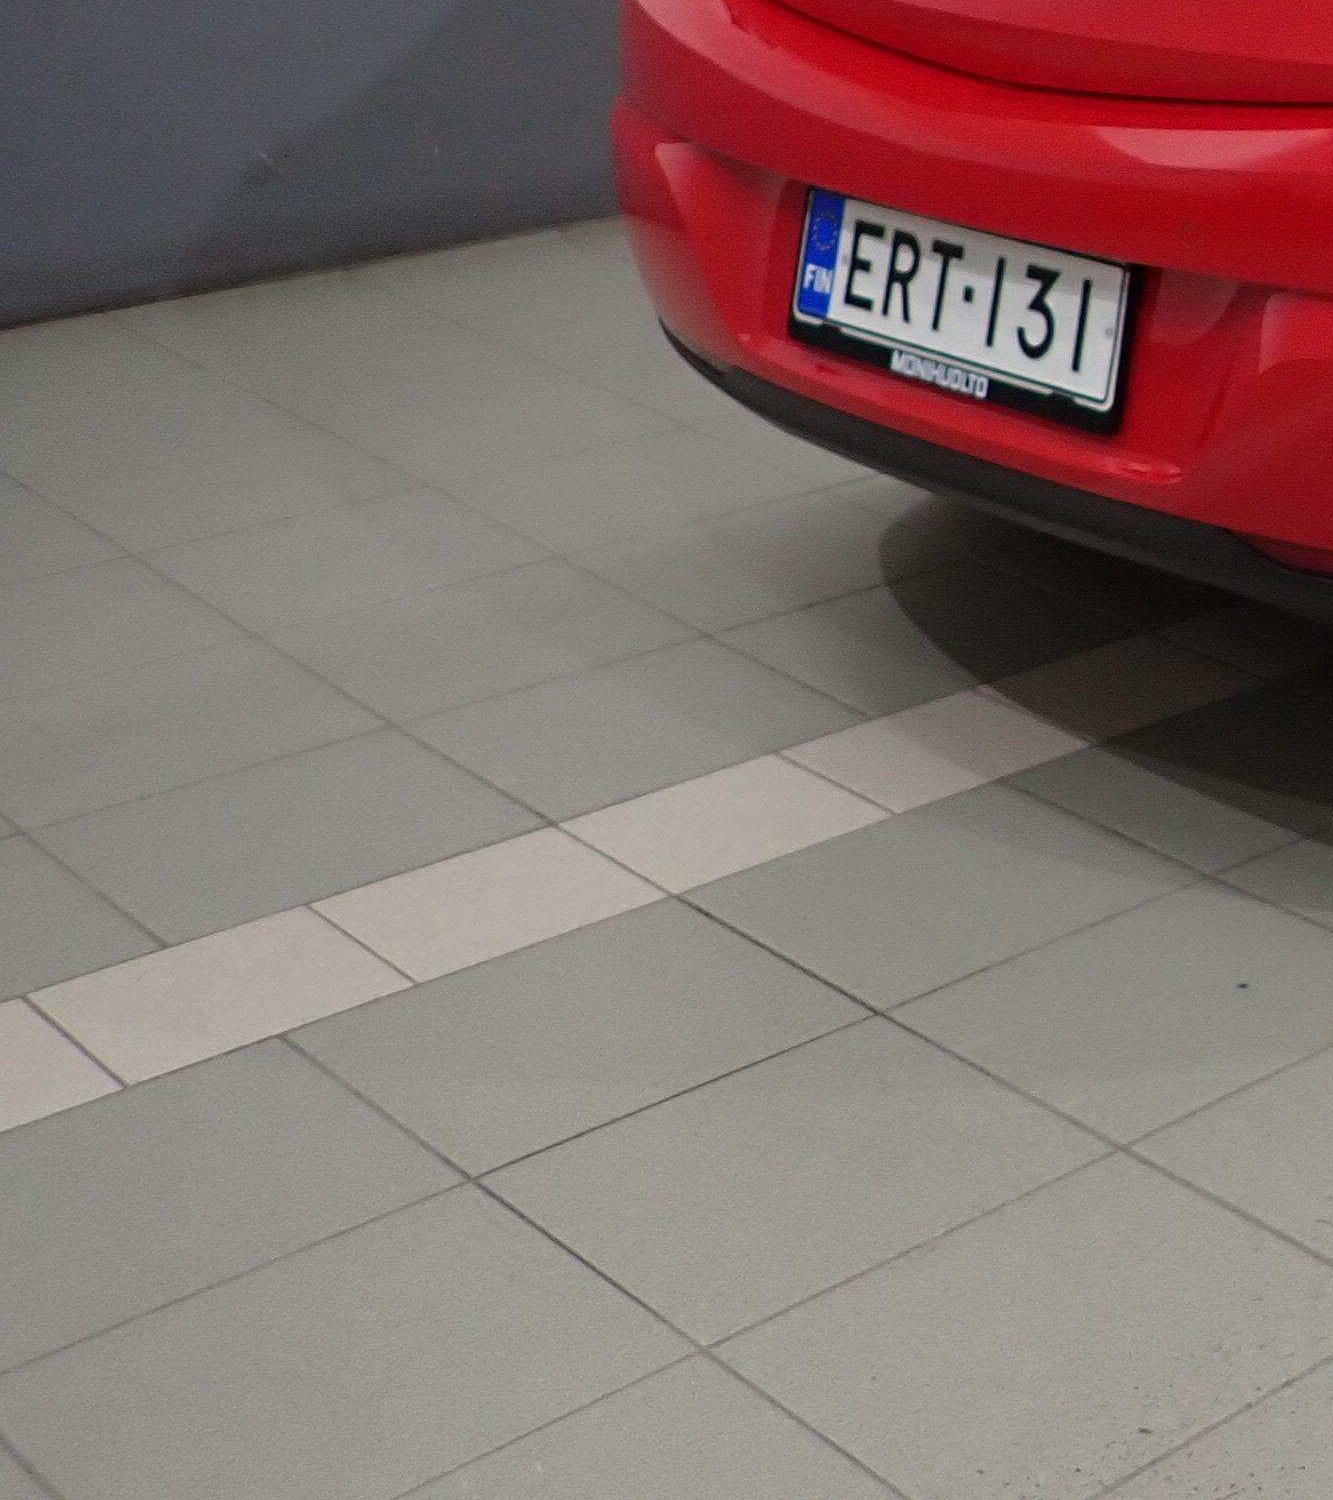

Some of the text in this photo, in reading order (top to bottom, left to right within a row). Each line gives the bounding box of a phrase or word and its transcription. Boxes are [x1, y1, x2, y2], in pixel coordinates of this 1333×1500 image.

[803, 263, 833, 294] FIN
[843, 219, 1092, 372] ERT-131
[889, 349, 989, 399] MONIHUOLTO
